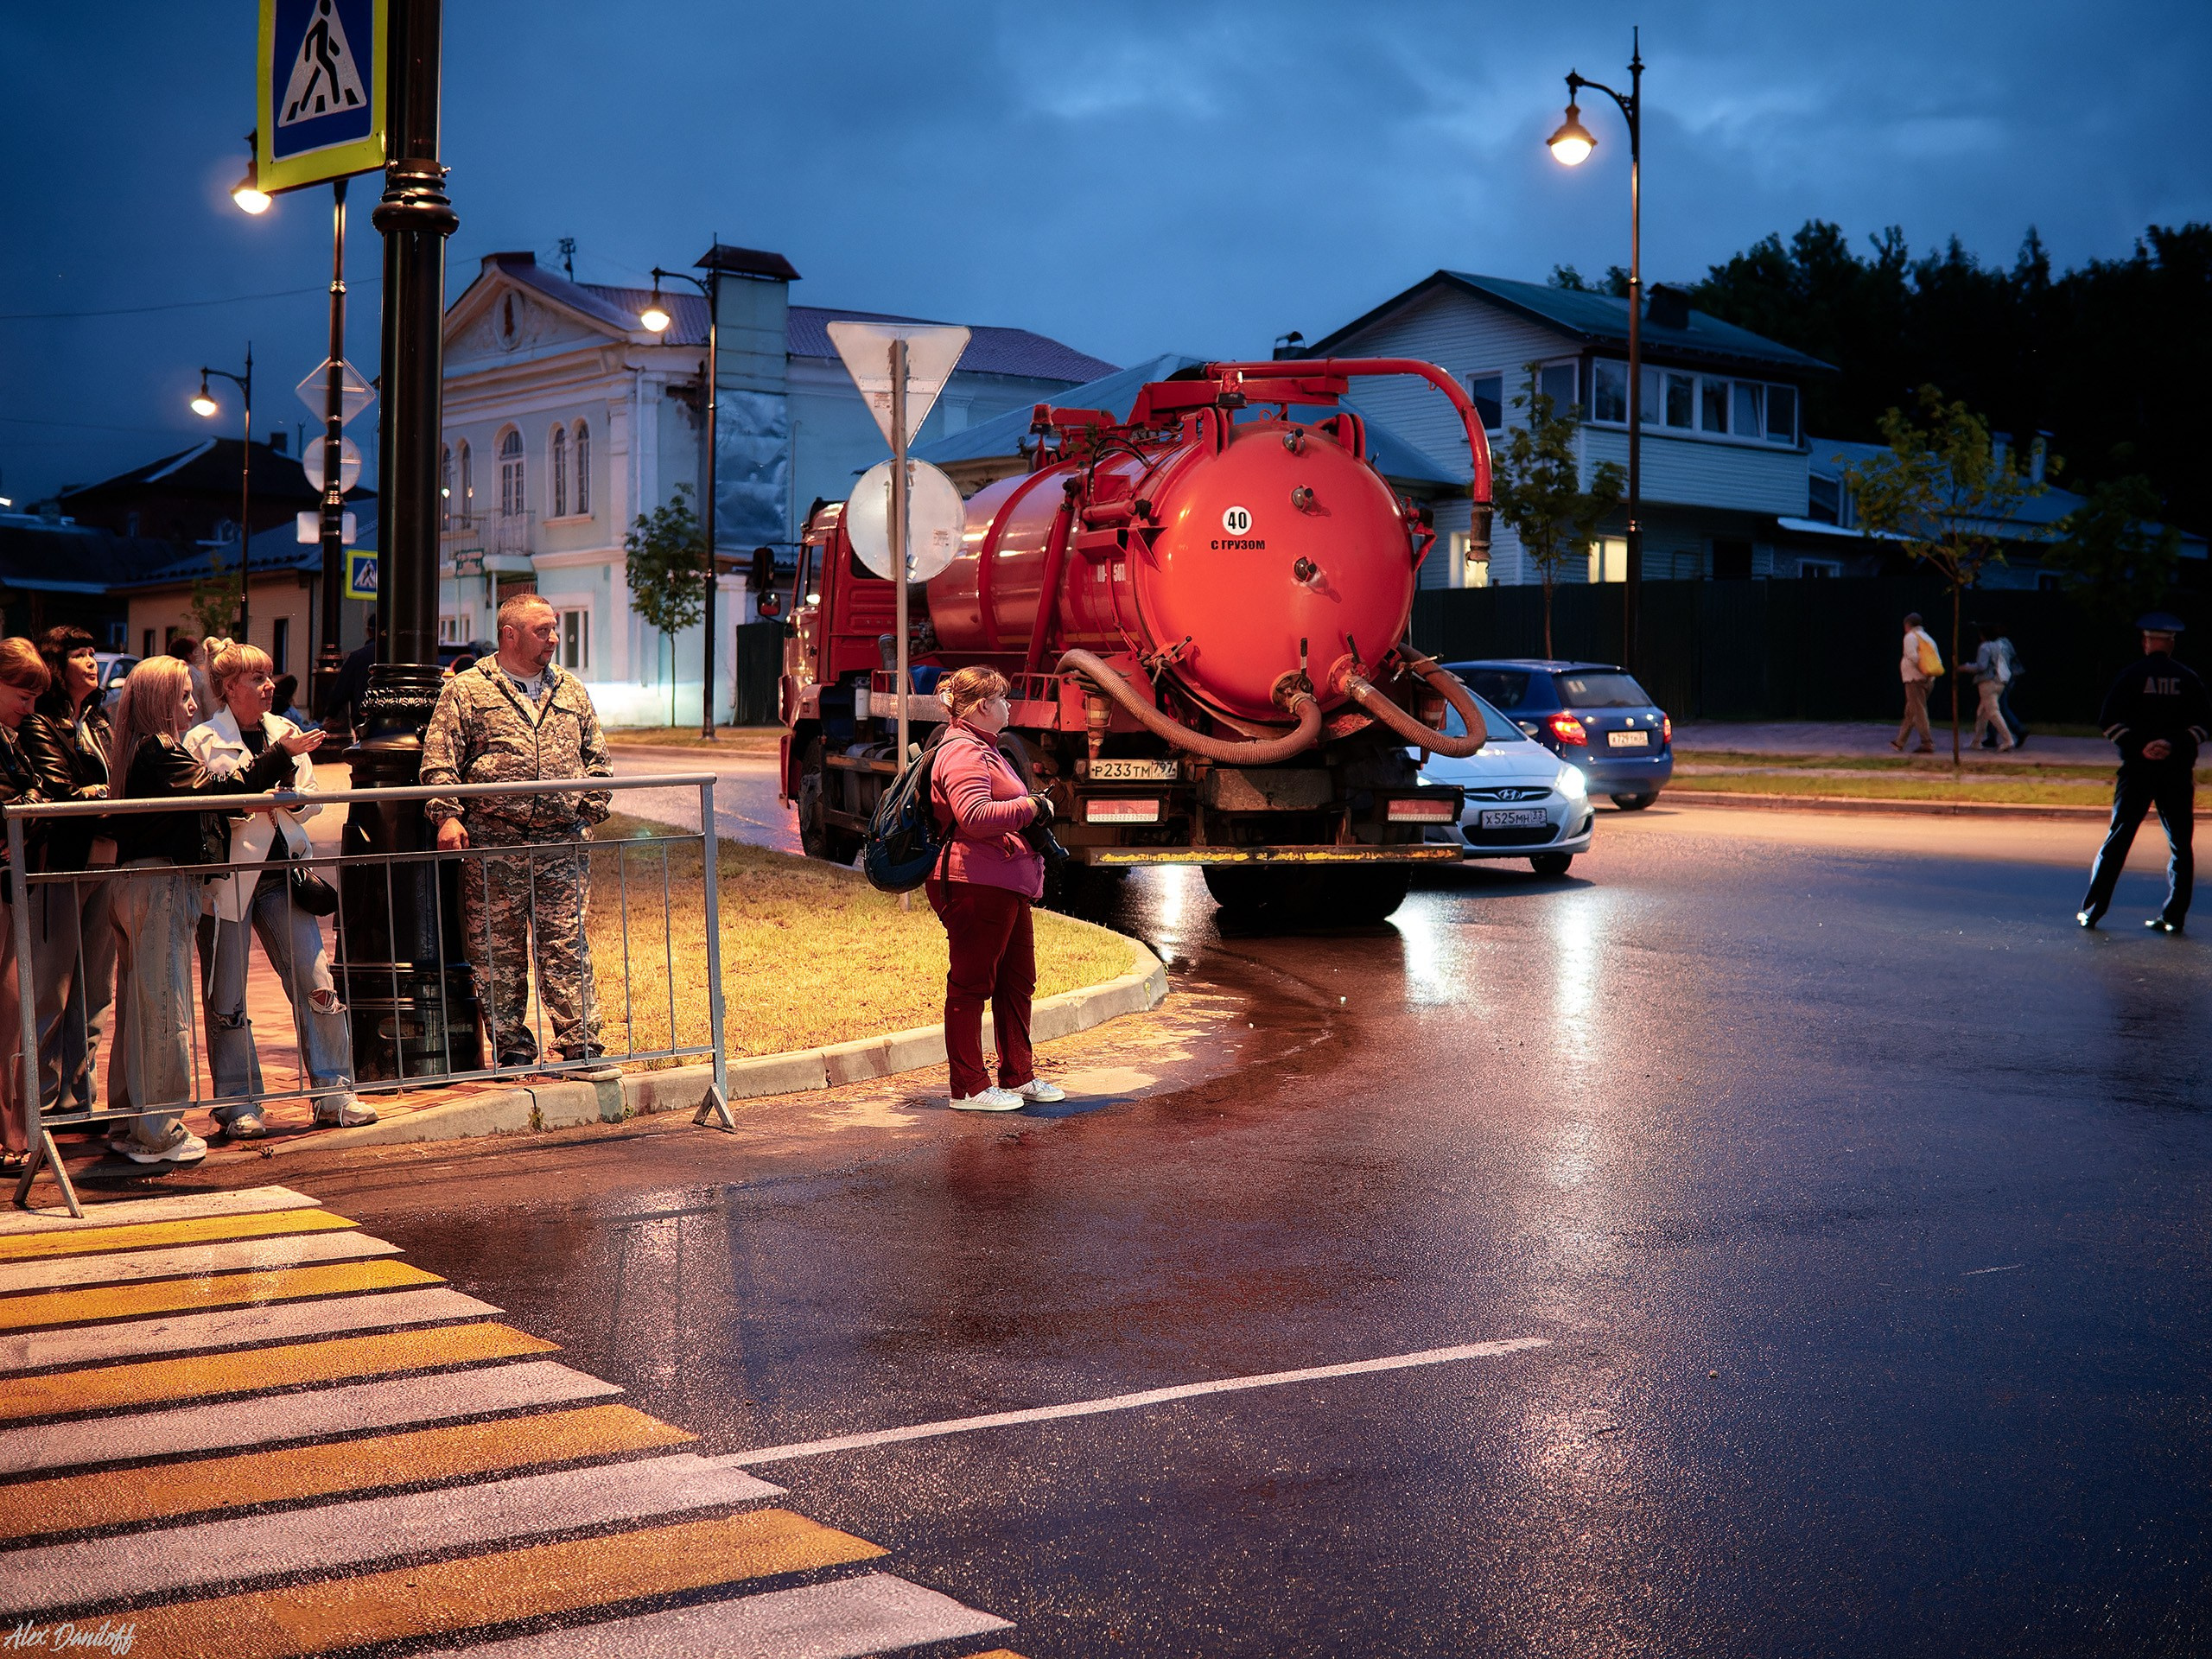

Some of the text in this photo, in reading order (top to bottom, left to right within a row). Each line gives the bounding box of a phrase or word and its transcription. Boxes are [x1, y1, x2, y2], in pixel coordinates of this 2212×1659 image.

[1228, 512, 1247, 529] 40
[1211, 540, 1265, 550] С ГРУЗОМ
[2143, 676, 2181, 695] ДПС
[1095, 762, 1173, 778] Р233ТМ 797
[1486, 812, 1530, 824] Х525МН
